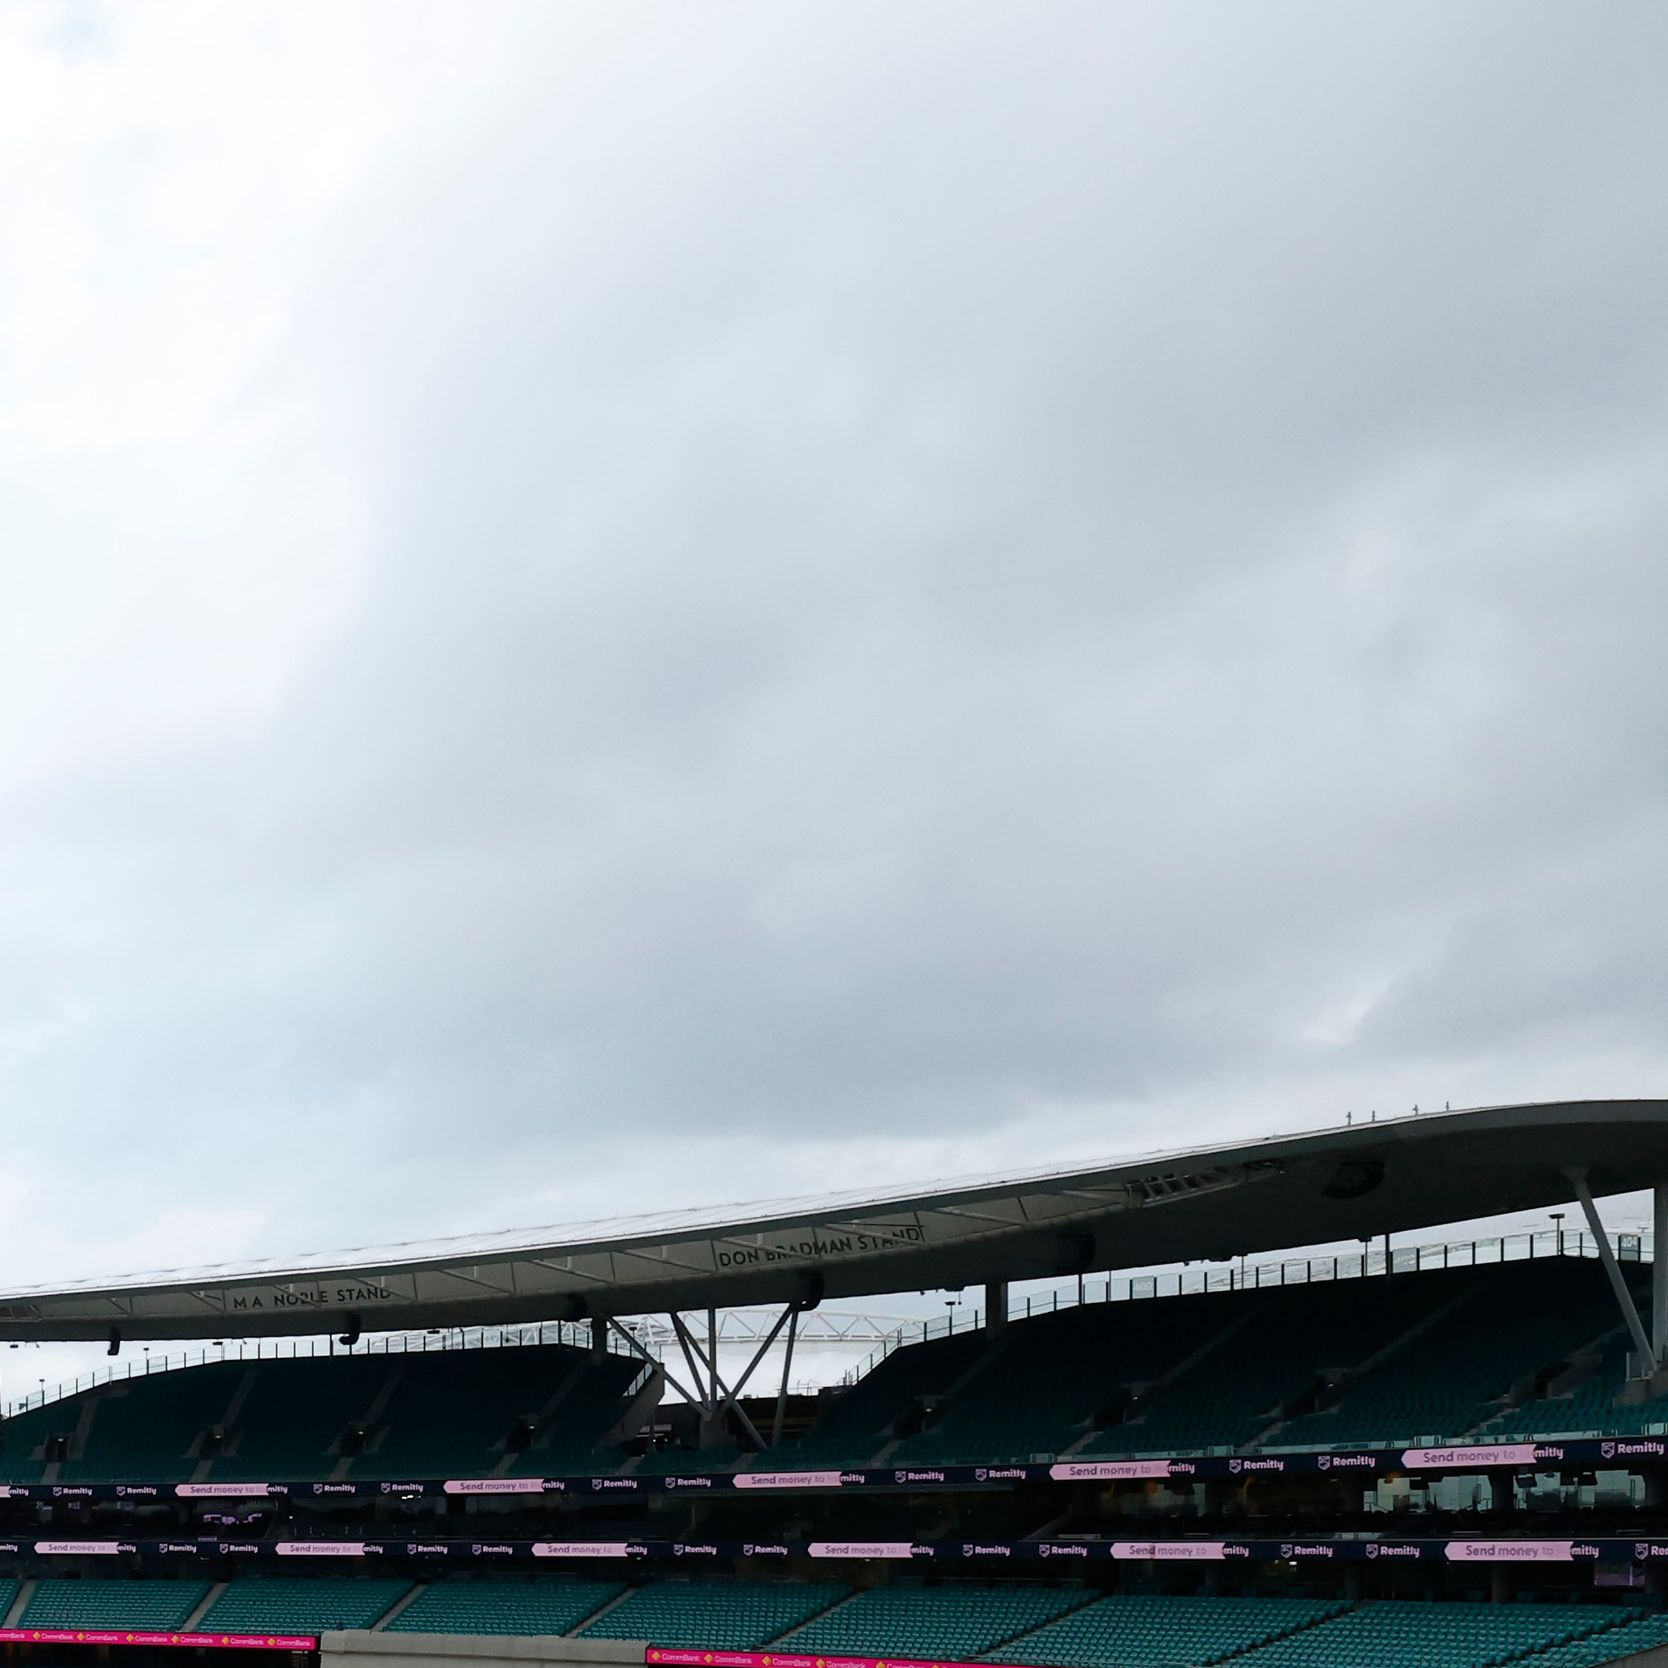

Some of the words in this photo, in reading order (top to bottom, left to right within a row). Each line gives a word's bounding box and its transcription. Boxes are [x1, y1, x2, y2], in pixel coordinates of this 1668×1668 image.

[719, 1247, 761, 1267] DON
[766, 1237, 853, 1263] BRADMAN
[858, 1227, 920, 1251] STAND
[233, 1296, 247, 1309] M
[252, 1295, 263, 1308] A
[337, 1286, 392, 1302] STAND
[1617, 1442, 1664, 1455] Remitly
[1333, 1456, 1375, 1467] Remitly
[1423, 1452, 1453, 1463] Send
[1456, 1451, 1498, 1461] money
[1243, 1459, 1284, 1471] Remitly
[908, 1471, 944, 1481] Remitly
[1069, 1466, 1097, 1476] Send
[1100, 1466, 1137, 1476] money
[604, 1479, 637, 1489] Remitly
[751, 1476, 776, 1484] Send
[778, 1475, 811, 1485] money
[324, 1484, 355, 1493] Remitly
[229, 1544, 258, 1553] Remitly
[418, 1545, 448, 1554] Remitly
[755, 1545, 788, 1555] Remitly
[975, 1545, 1011, 1556] Remitly
[1129, 1546, 1155, 1555] Send
[1158, 1547, 1192, 1556] money
[1294, 1546, 1333, 1557] Remitly
[1380, 1546, 1421, 1558] Remitly
[1465, 1545, 1495, 1556] Send
[1498, 1546, 1538, 1557] money
[661, 1654, 700, 1662] CommBank
